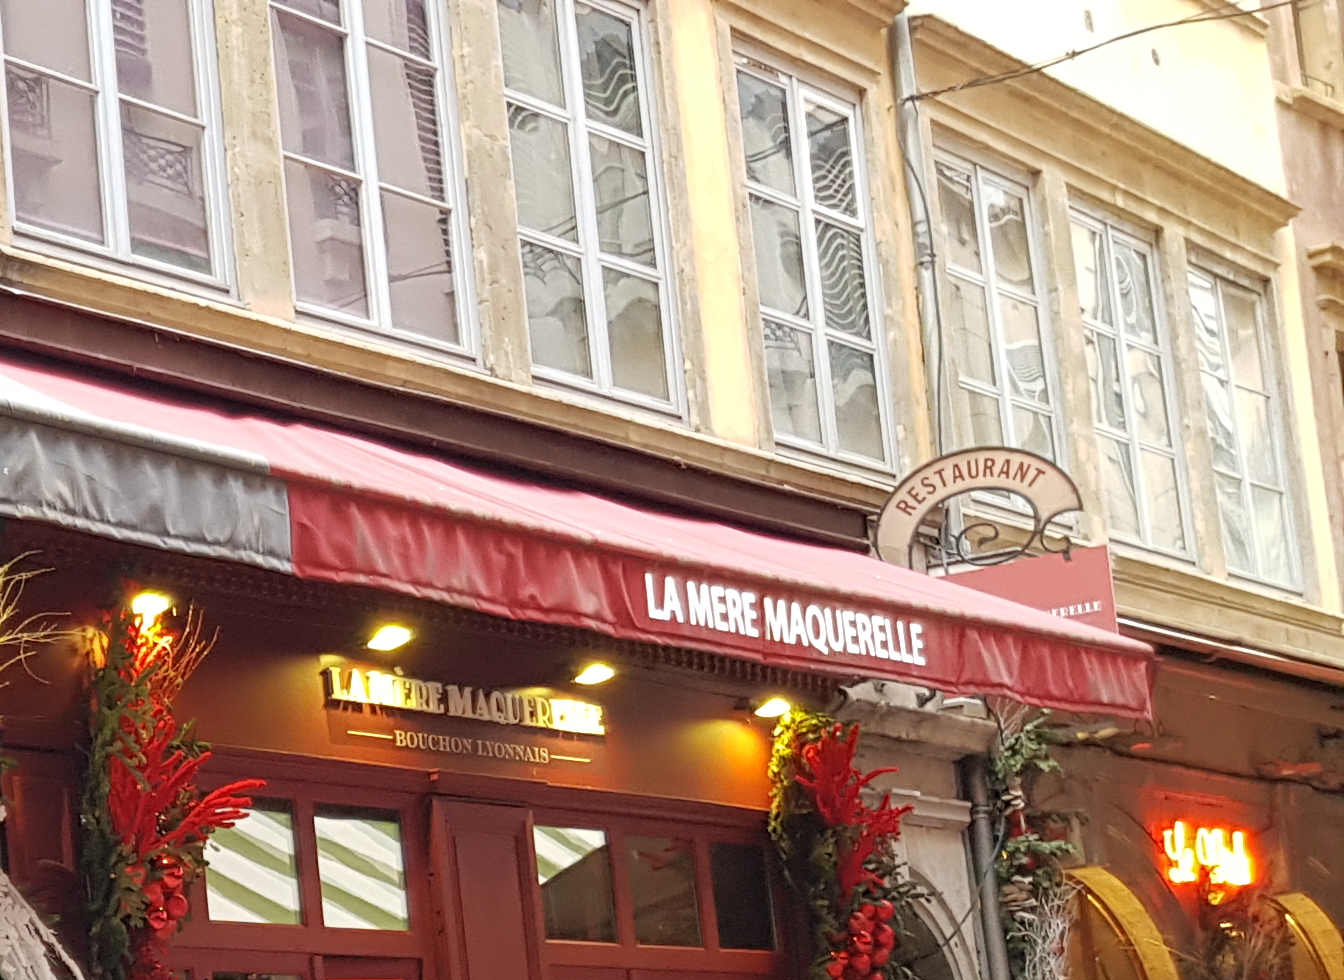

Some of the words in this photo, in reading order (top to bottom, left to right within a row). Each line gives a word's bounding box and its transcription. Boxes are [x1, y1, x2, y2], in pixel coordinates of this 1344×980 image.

[895, 457, 1046, 517] RESTAURANT
[644, 572, 684, 623] LA
[686, 580, 760, 638] MERE
[763, 596, 927, 666] MAQUERELLE
[1048, 600, 1101, 617] ERELLE
[325, 666, 368, 705] LA
[394, 729, 472, 754] BOUCHON
[476, 738, 550, 764] LYONNAIS
